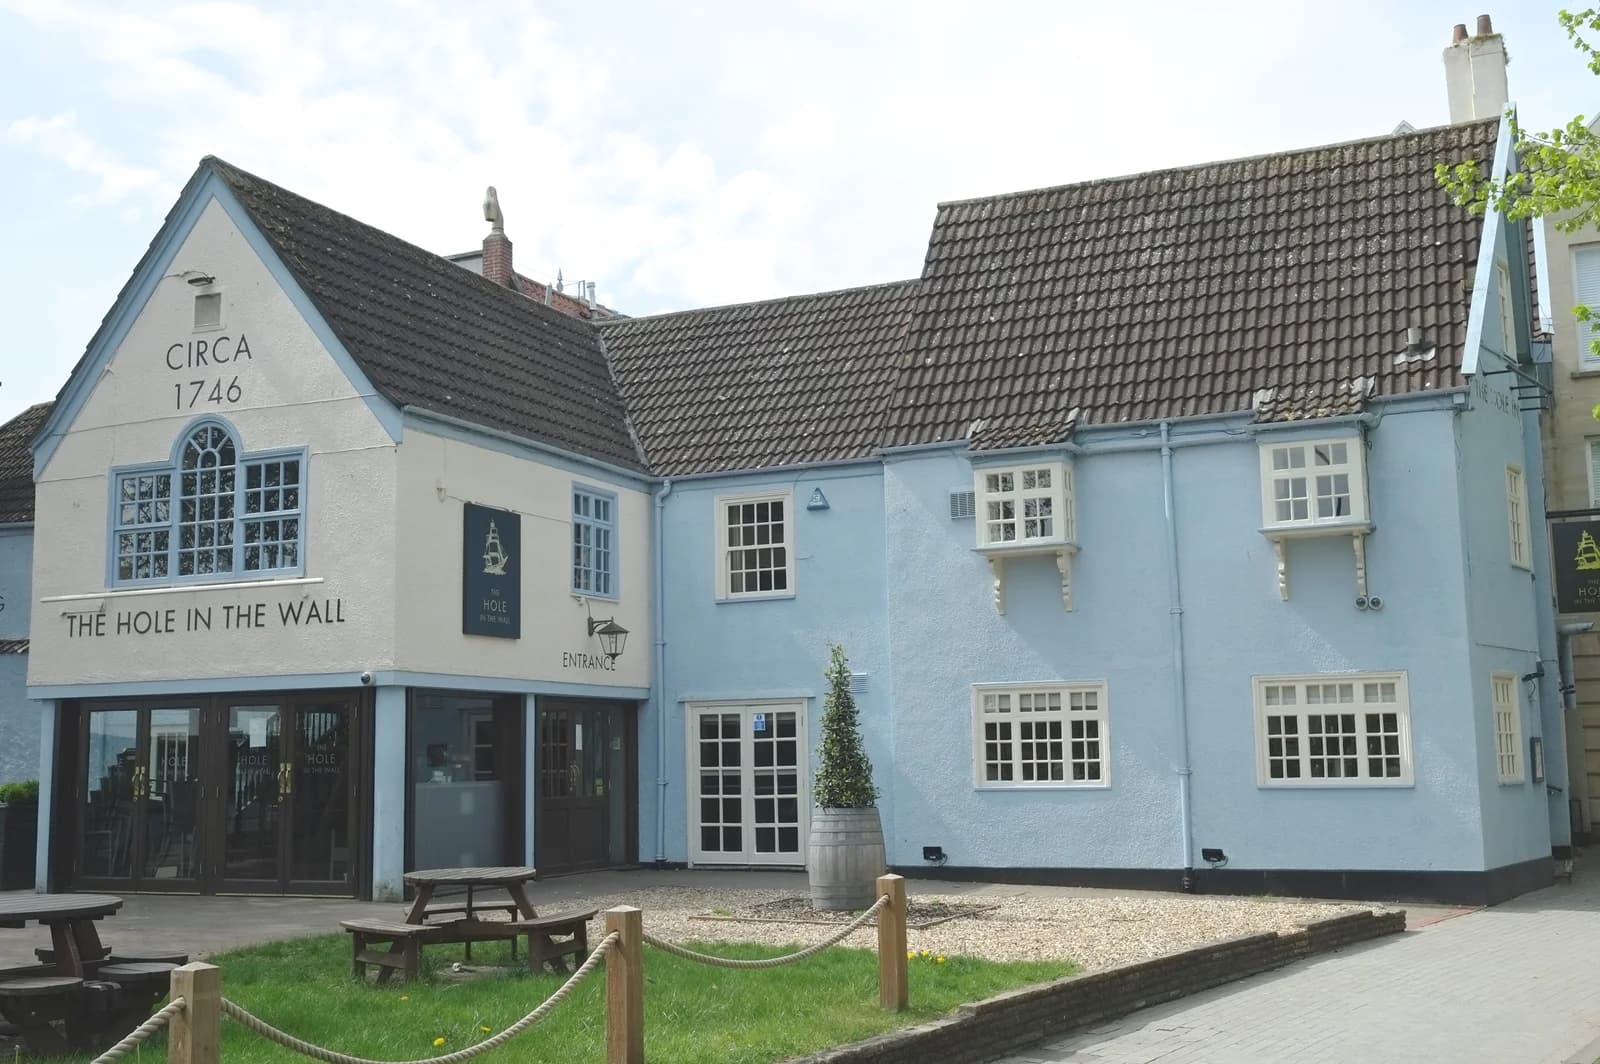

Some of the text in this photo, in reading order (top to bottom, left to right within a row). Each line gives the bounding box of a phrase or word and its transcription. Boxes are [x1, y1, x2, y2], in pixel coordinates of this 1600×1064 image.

[166, 333, 252, 370] CIRCA
[174, 375, 242, 410] 1746
[483, 599, 508, 613] HOLE
[67, 598, 345, 638] THE HOLE IN THE WALL
[487, 615, 497, 624] THE
[562, 651, 616, 672] ENTRANCE
[307, 753, 336, 765] HOLE
